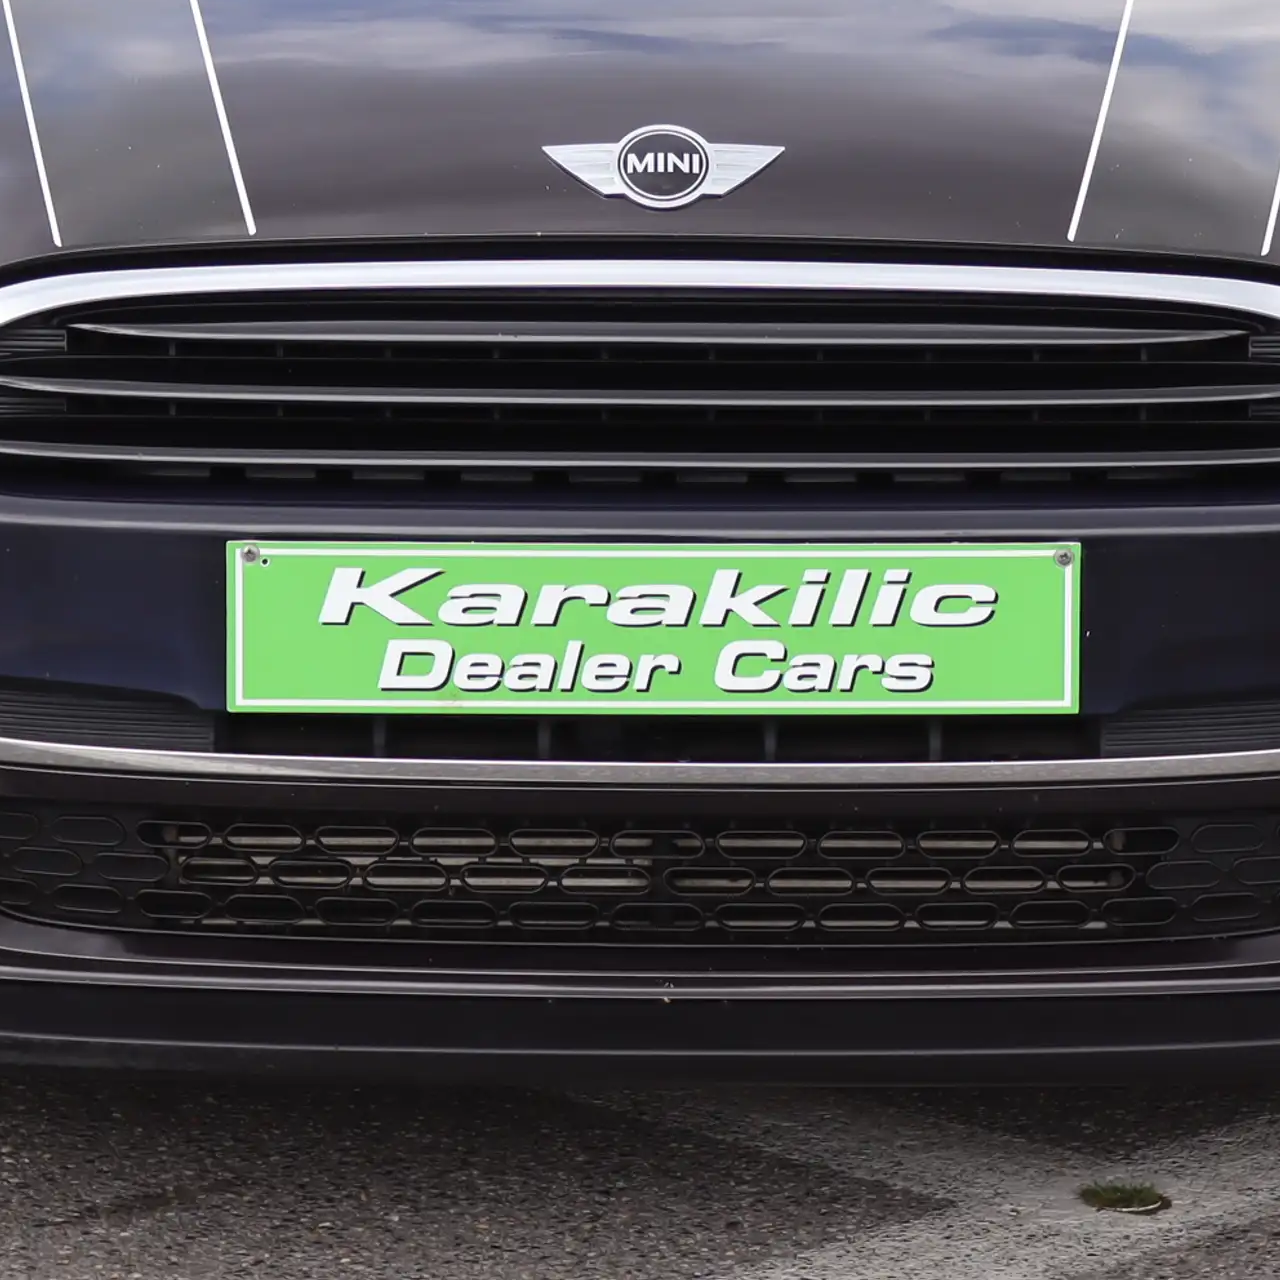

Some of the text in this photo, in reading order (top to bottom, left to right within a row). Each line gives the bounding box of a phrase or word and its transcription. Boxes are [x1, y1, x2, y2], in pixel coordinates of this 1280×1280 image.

[627, 152, 700, 174] MINI
[318, 567, 999, 627] Karakilic
[377, 639, 935, 693] Dealer Cars
